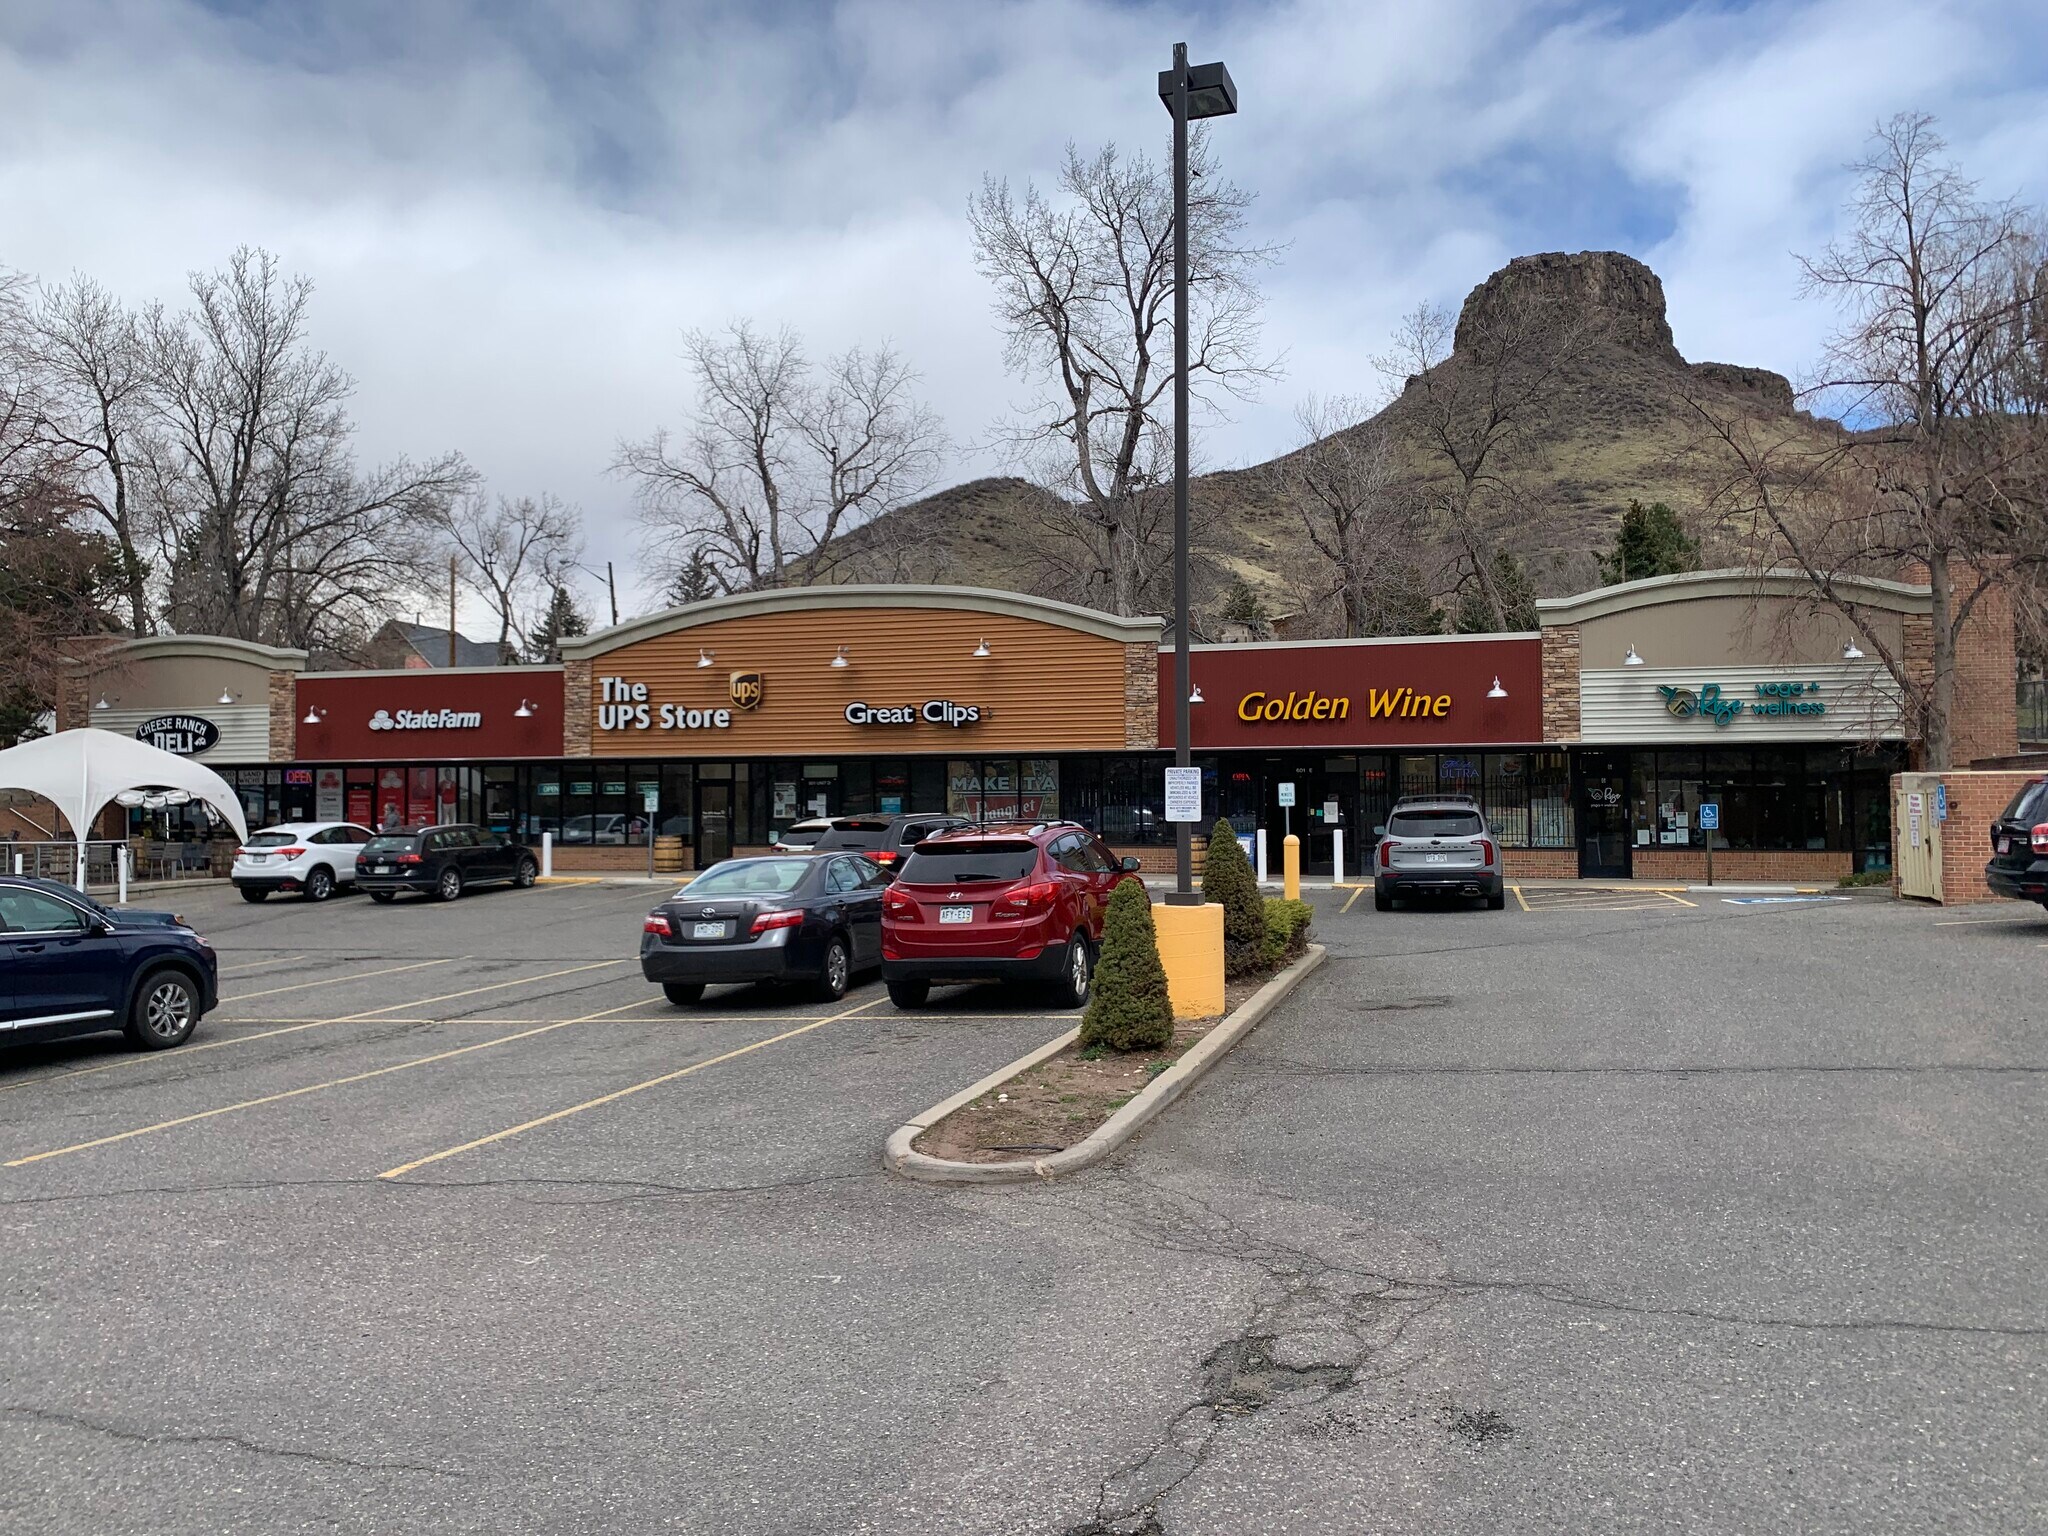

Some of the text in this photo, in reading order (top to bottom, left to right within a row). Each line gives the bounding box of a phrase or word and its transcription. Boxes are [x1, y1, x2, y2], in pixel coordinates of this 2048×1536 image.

[598, 677, 647, 701] The
[732, 682, 758, 704] ups
[1755, 682, 1804, 698] yoga
[844, 701, 979, 727] Great Clips
[1238, 687, 1451, 721] Golden Wine
[1700, 683, 1745, 726] Rise
[1751, 700, 1826, 716] wellness
[394, 708, 481, 729] StateFarm
[598, 703, 730, 730] UPS Store
[139, 718, 207, 737] CHEESE RANCH
[153, 732, 194, 753] DELI
[287, 771, 313, 784] OPEN
[951, 776, 1009, 791] MAKE
[1044, 776, 1057, 791] A
[1232, 773, 1251, 781] OPEN
[1439, 768, 1480, 779] ULTRA
